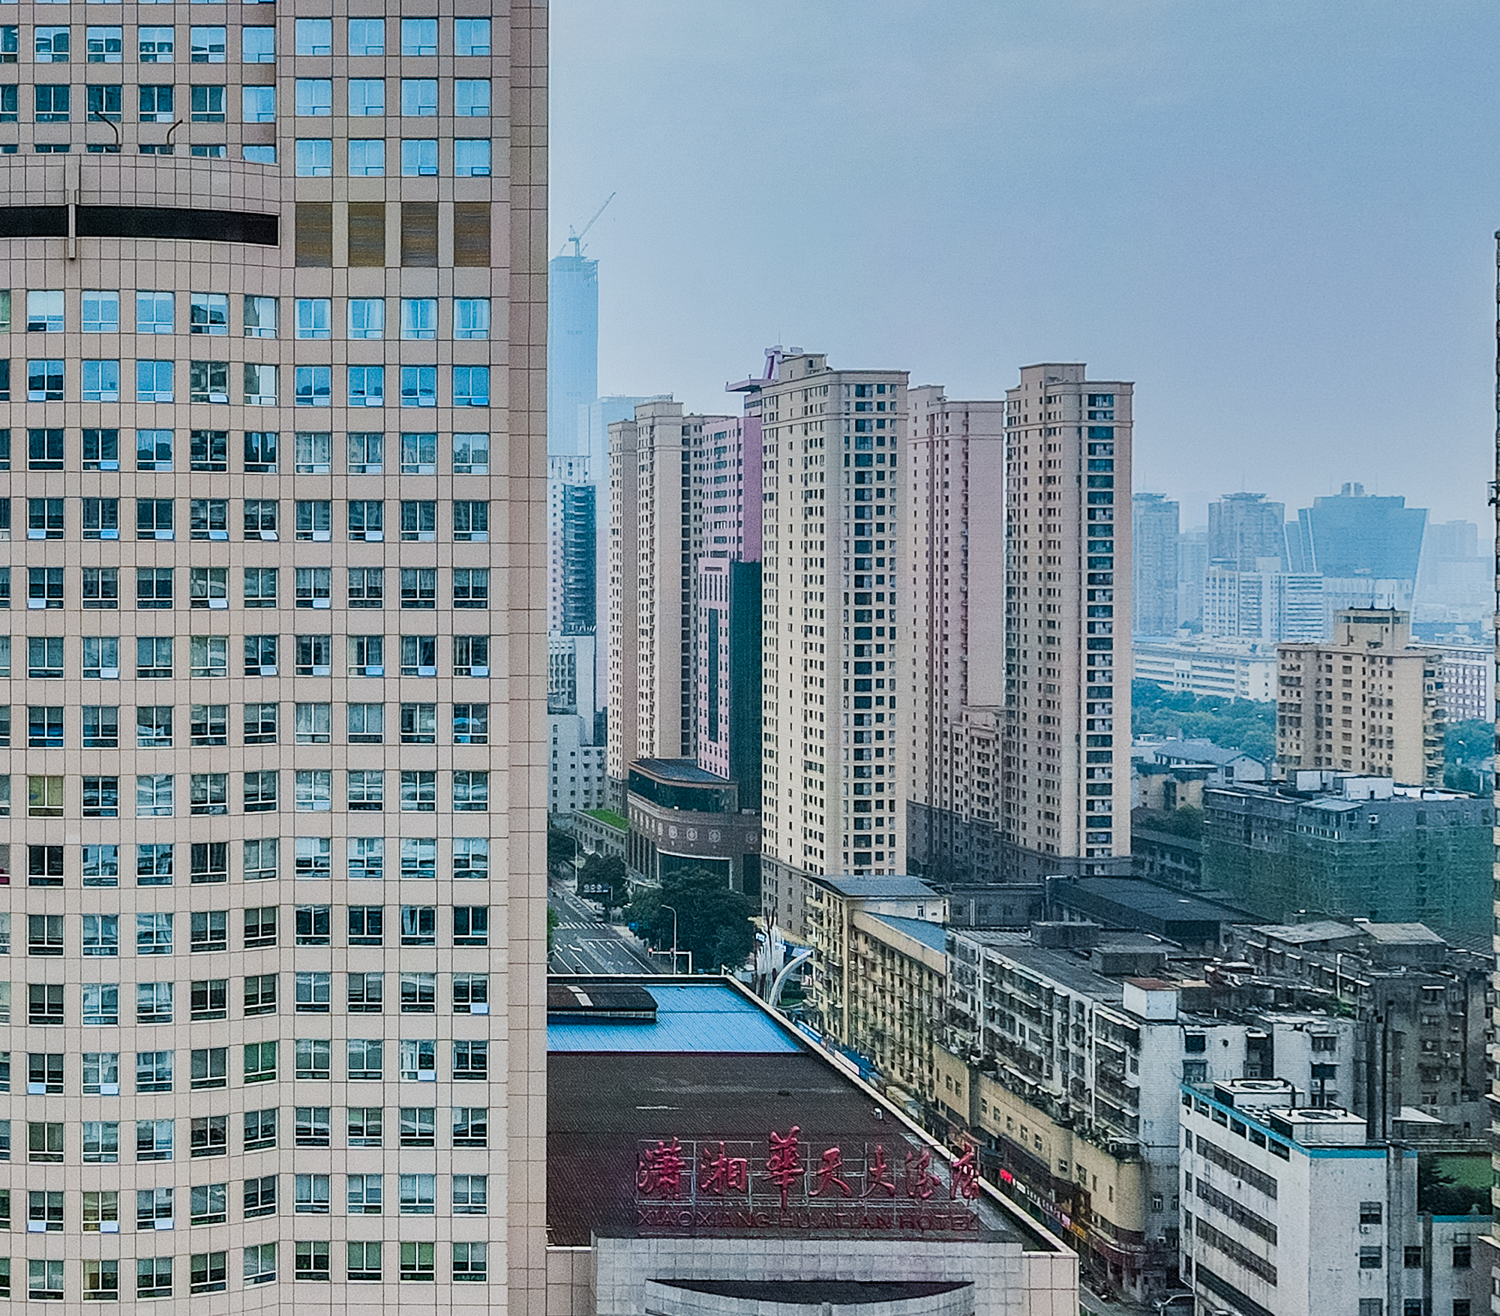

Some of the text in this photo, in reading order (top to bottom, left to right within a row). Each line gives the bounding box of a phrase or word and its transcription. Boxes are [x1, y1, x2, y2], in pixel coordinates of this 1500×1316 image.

[638, 1210, 980, 1232] XIAOXIANG HUATIAN HOTEL
